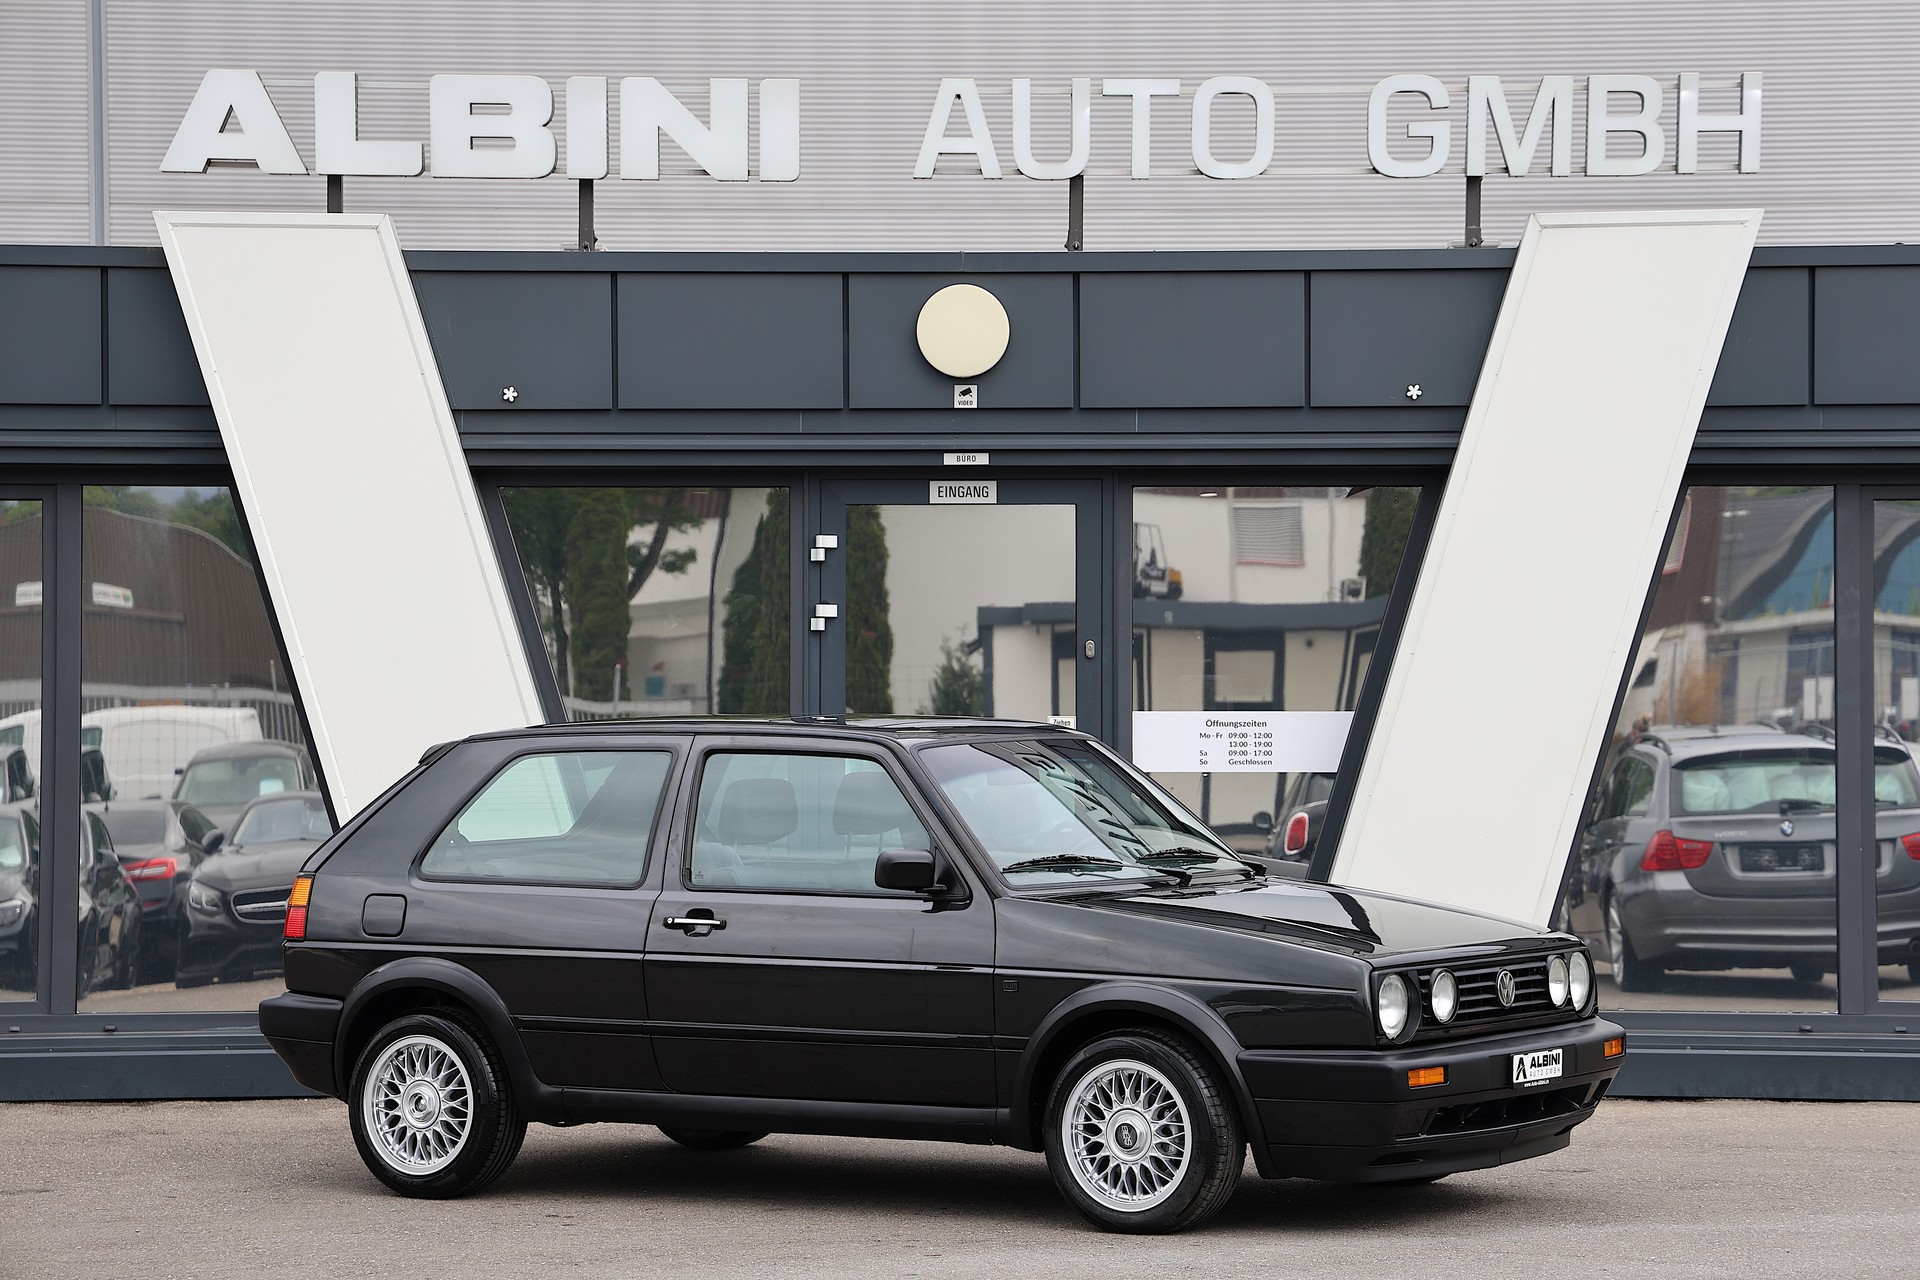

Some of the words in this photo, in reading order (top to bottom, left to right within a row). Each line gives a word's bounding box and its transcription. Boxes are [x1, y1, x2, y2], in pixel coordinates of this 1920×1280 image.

[159, 68, 801, 182] ALBINI
[913, 75, 1276, 180] AUTO
[1367, 70, 1764, 179] GMBH
[956, 454, 977, 462] BÜRO
[937, 485, 989, 498] EINGANG
[1205, 718, 1267, 728] Öffnungszeiten
[1530, 1052, 1560, 1069] ALBINI
